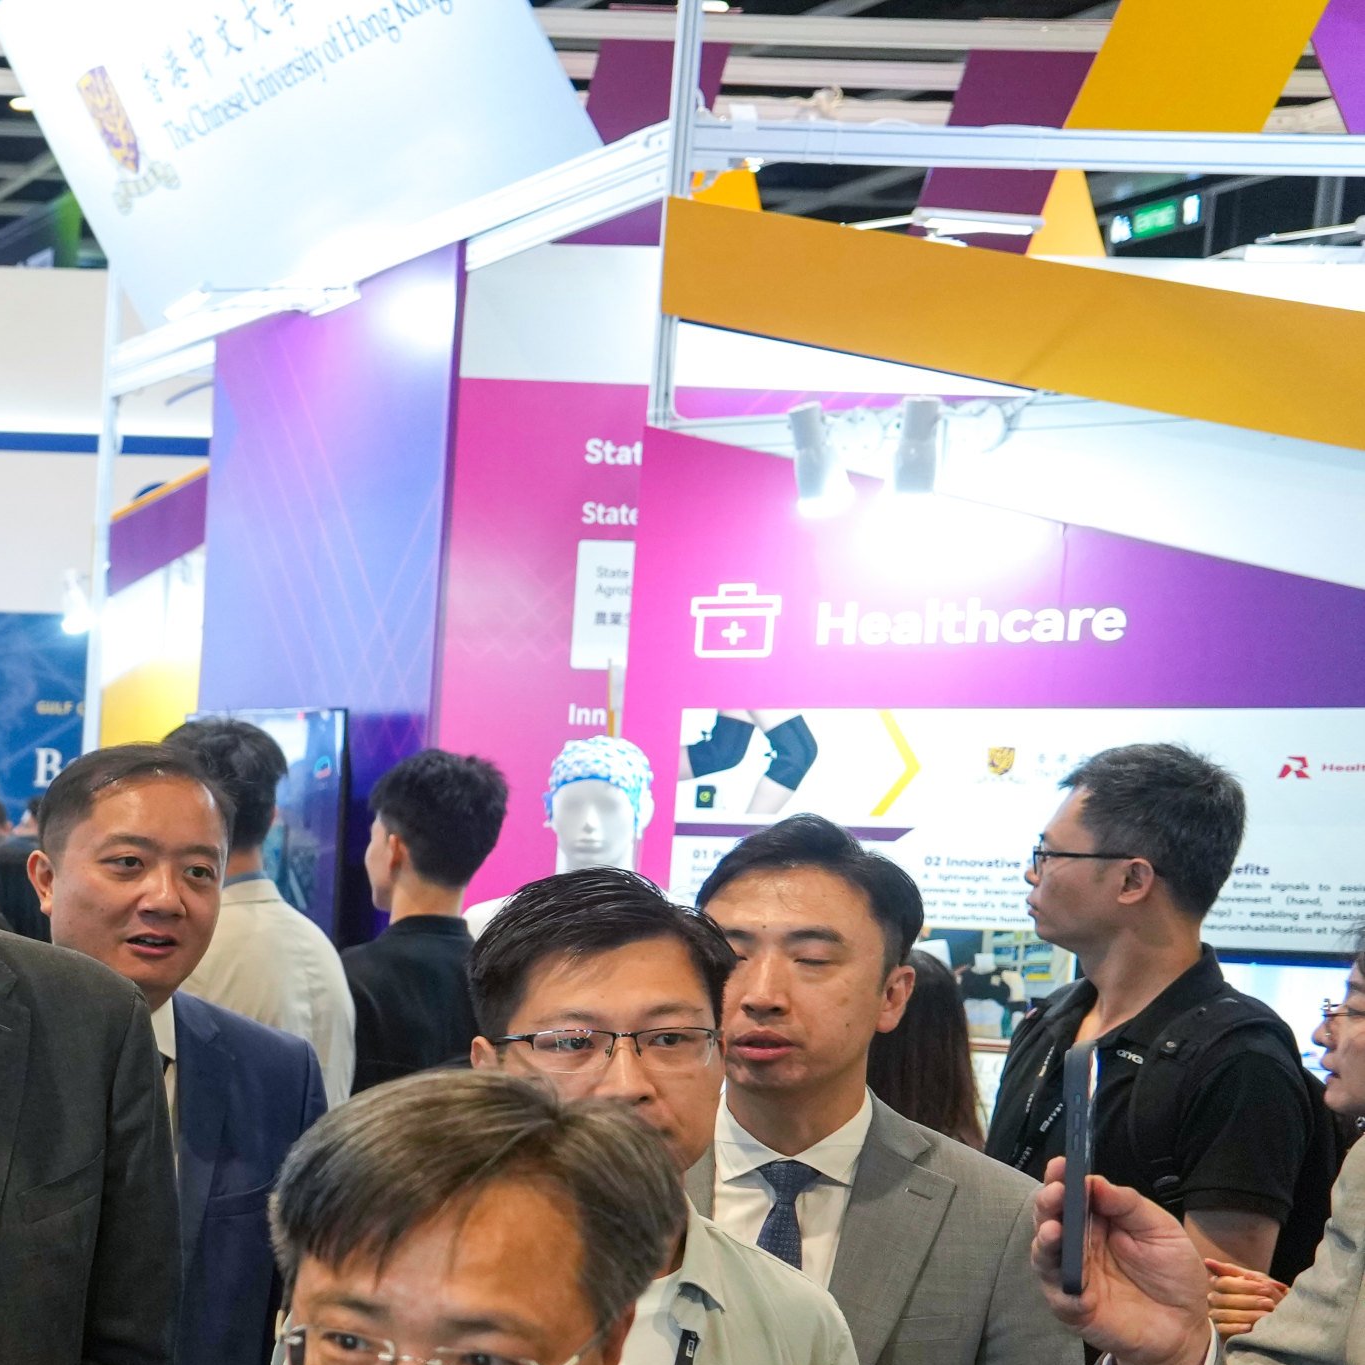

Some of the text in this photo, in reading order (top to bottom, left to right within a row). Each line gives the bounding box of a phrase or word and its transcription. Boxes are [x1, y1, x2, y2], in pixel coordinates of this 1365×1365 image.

[188, 99, 249, 138] Chinese
[240, 46, 328, 106] University
[322, 25, 346, 63] of
[336, 6, 403, 52] Hong
[816, 597, 1127, 645] Healthcare
[946, 857, 1021, 868] Innovative
[1270, 882, 1310, 892] signals
[1319, 883, 1331, 892] to
